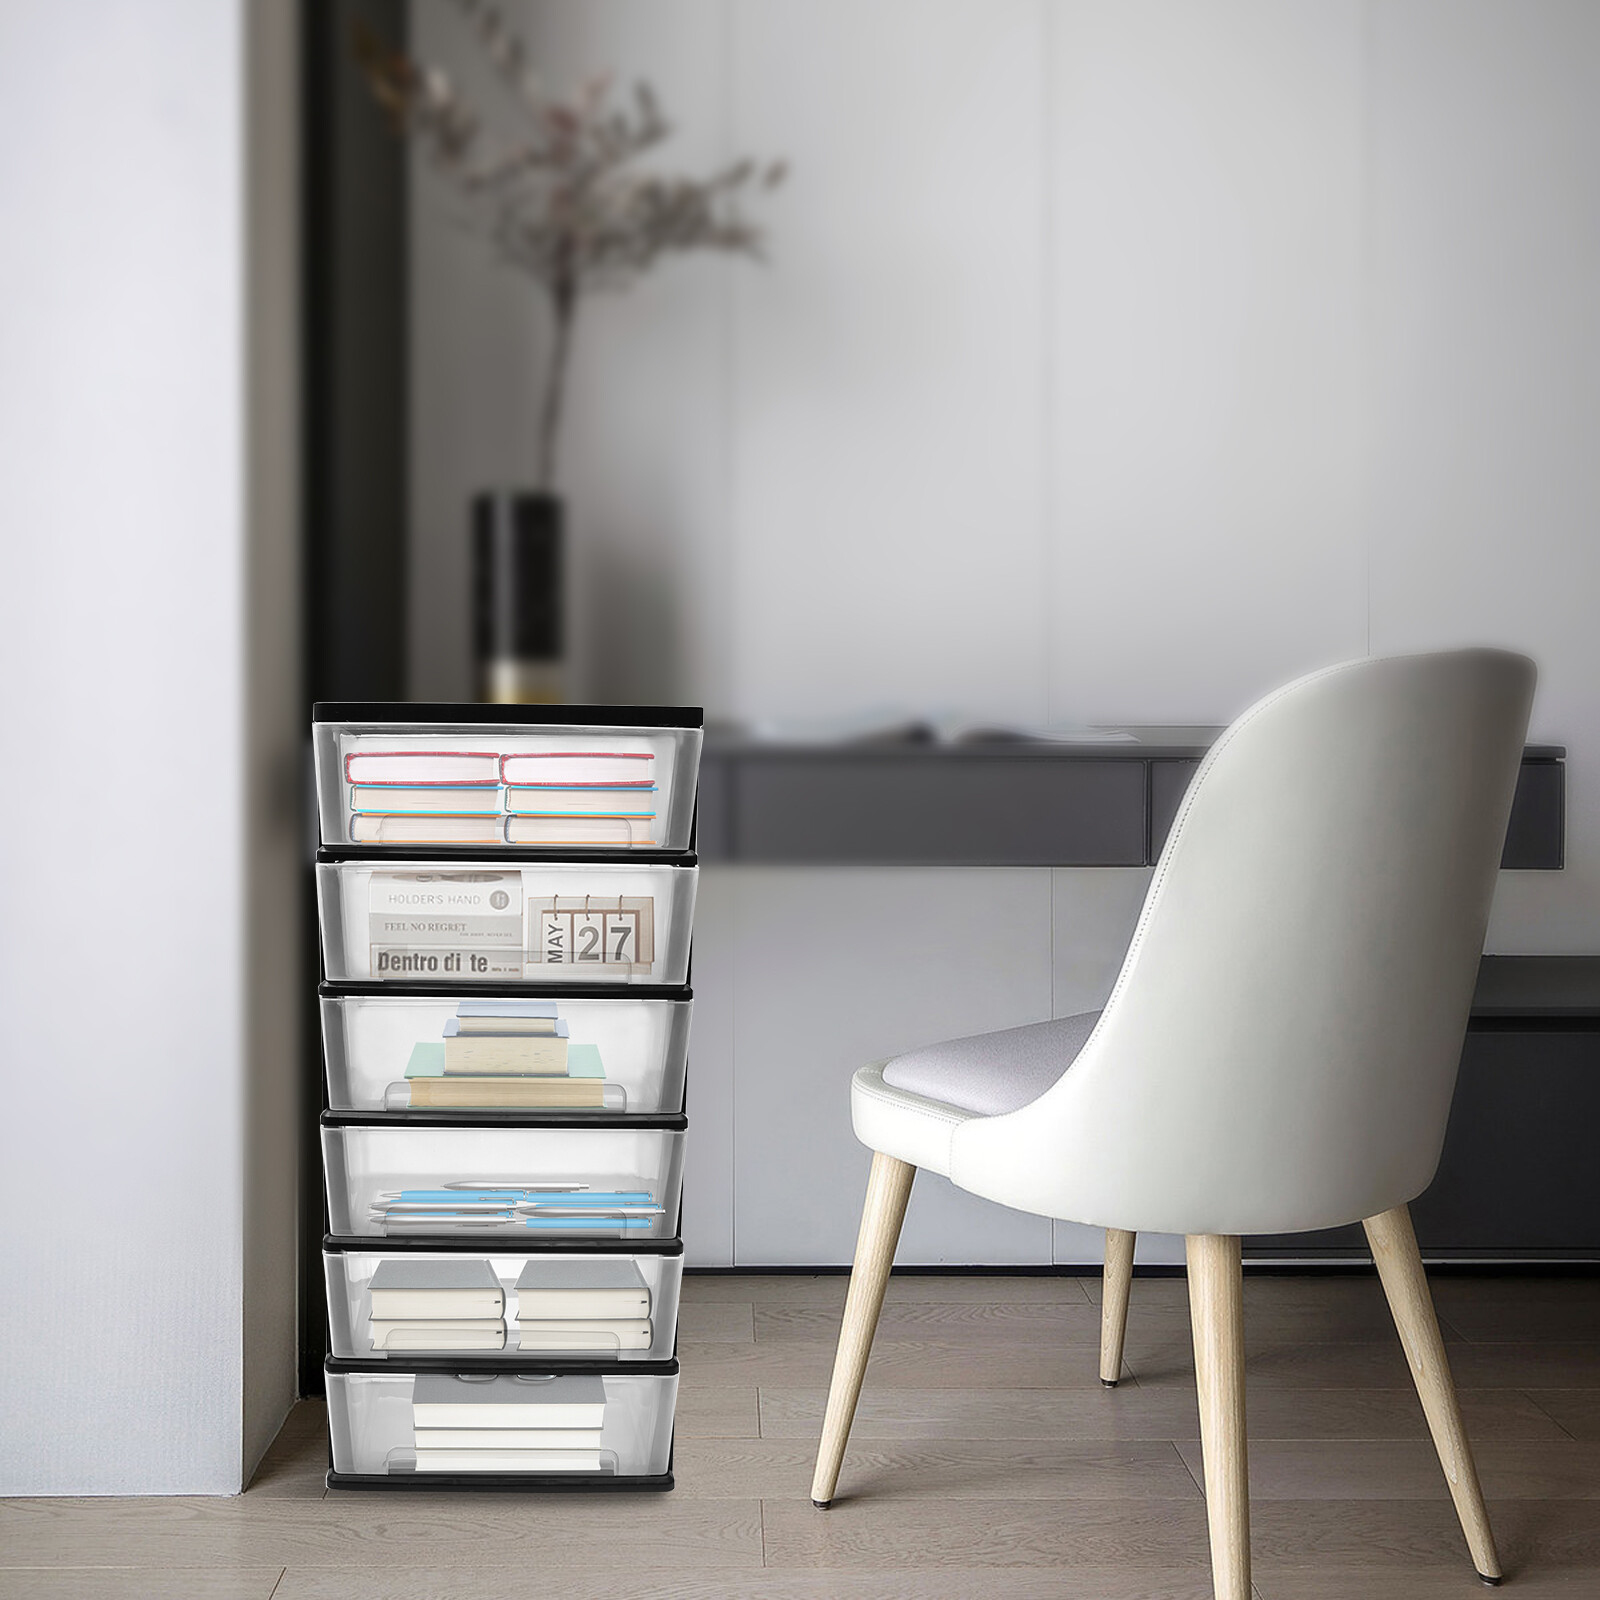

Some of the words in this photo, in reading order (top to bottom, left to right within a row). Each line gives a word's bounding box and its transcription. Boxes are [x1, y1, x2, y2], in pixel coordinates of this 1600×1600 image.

[448, 895, 481, 905] HAND
[384, 922, 408, 931] FEEL
[411, 922, 426, 931] NO
[428, 922, 467, 932] REGRET
[547, 923, 564, 963] MAY
[377, 951, 438, 972] Dentro
[444, 952, 461, 972] di
[469, 953, 488, 972] te
